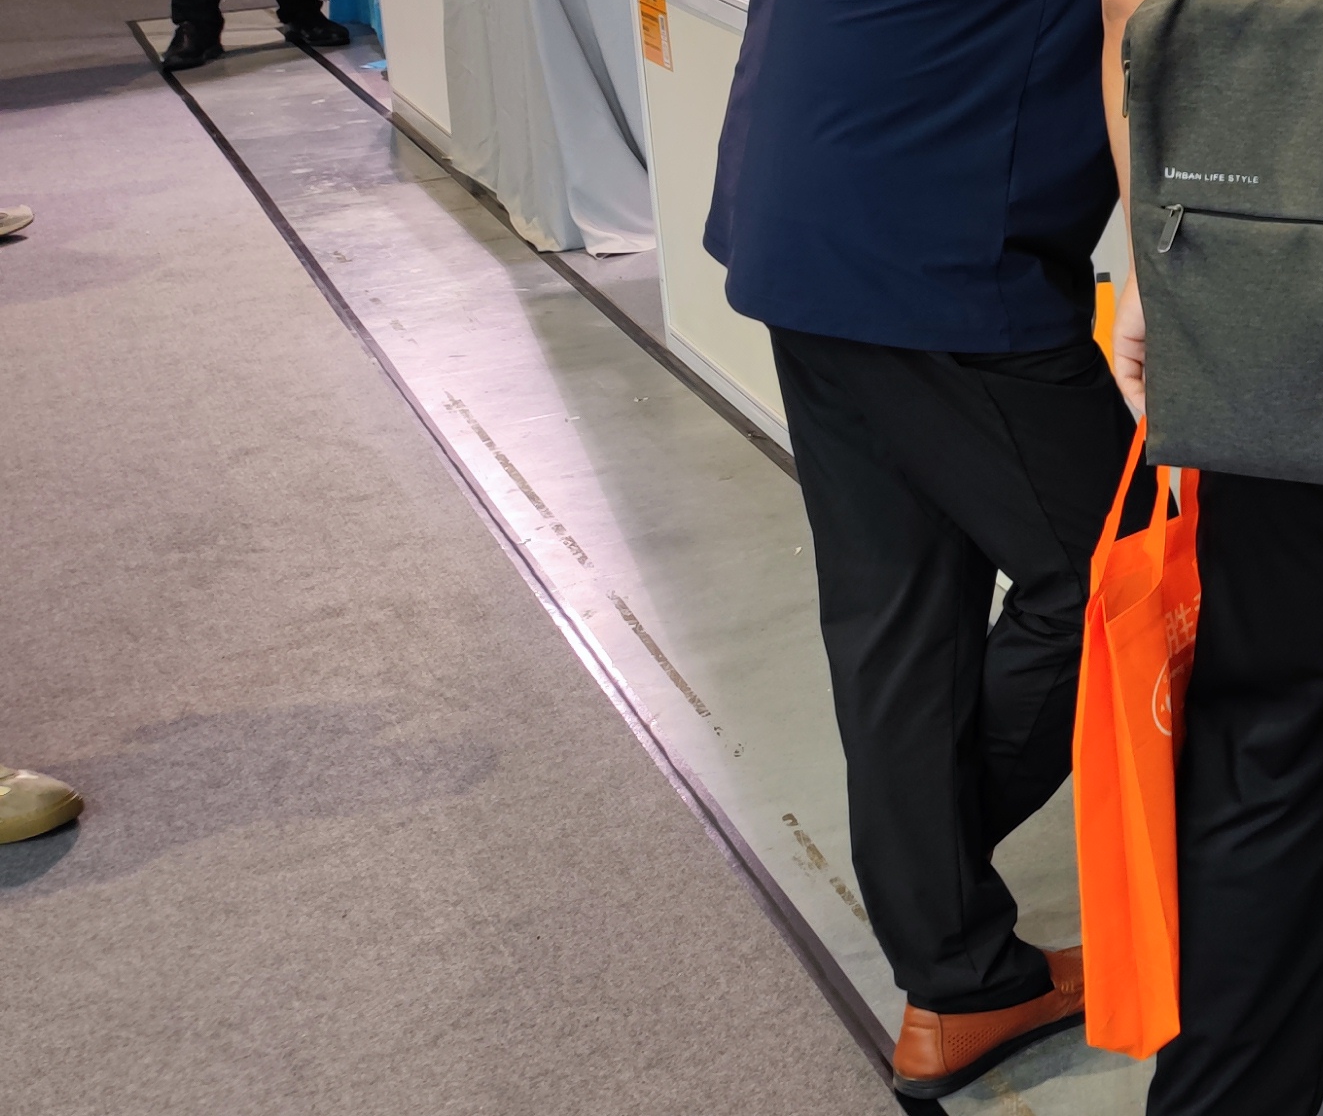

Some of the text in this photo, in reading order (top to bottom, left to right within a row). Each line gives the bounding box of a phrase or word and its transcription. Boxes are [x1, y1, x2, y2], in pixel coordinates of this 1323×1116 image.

[1164, 167, 1260, 184] URBAN LIFE STYLE
